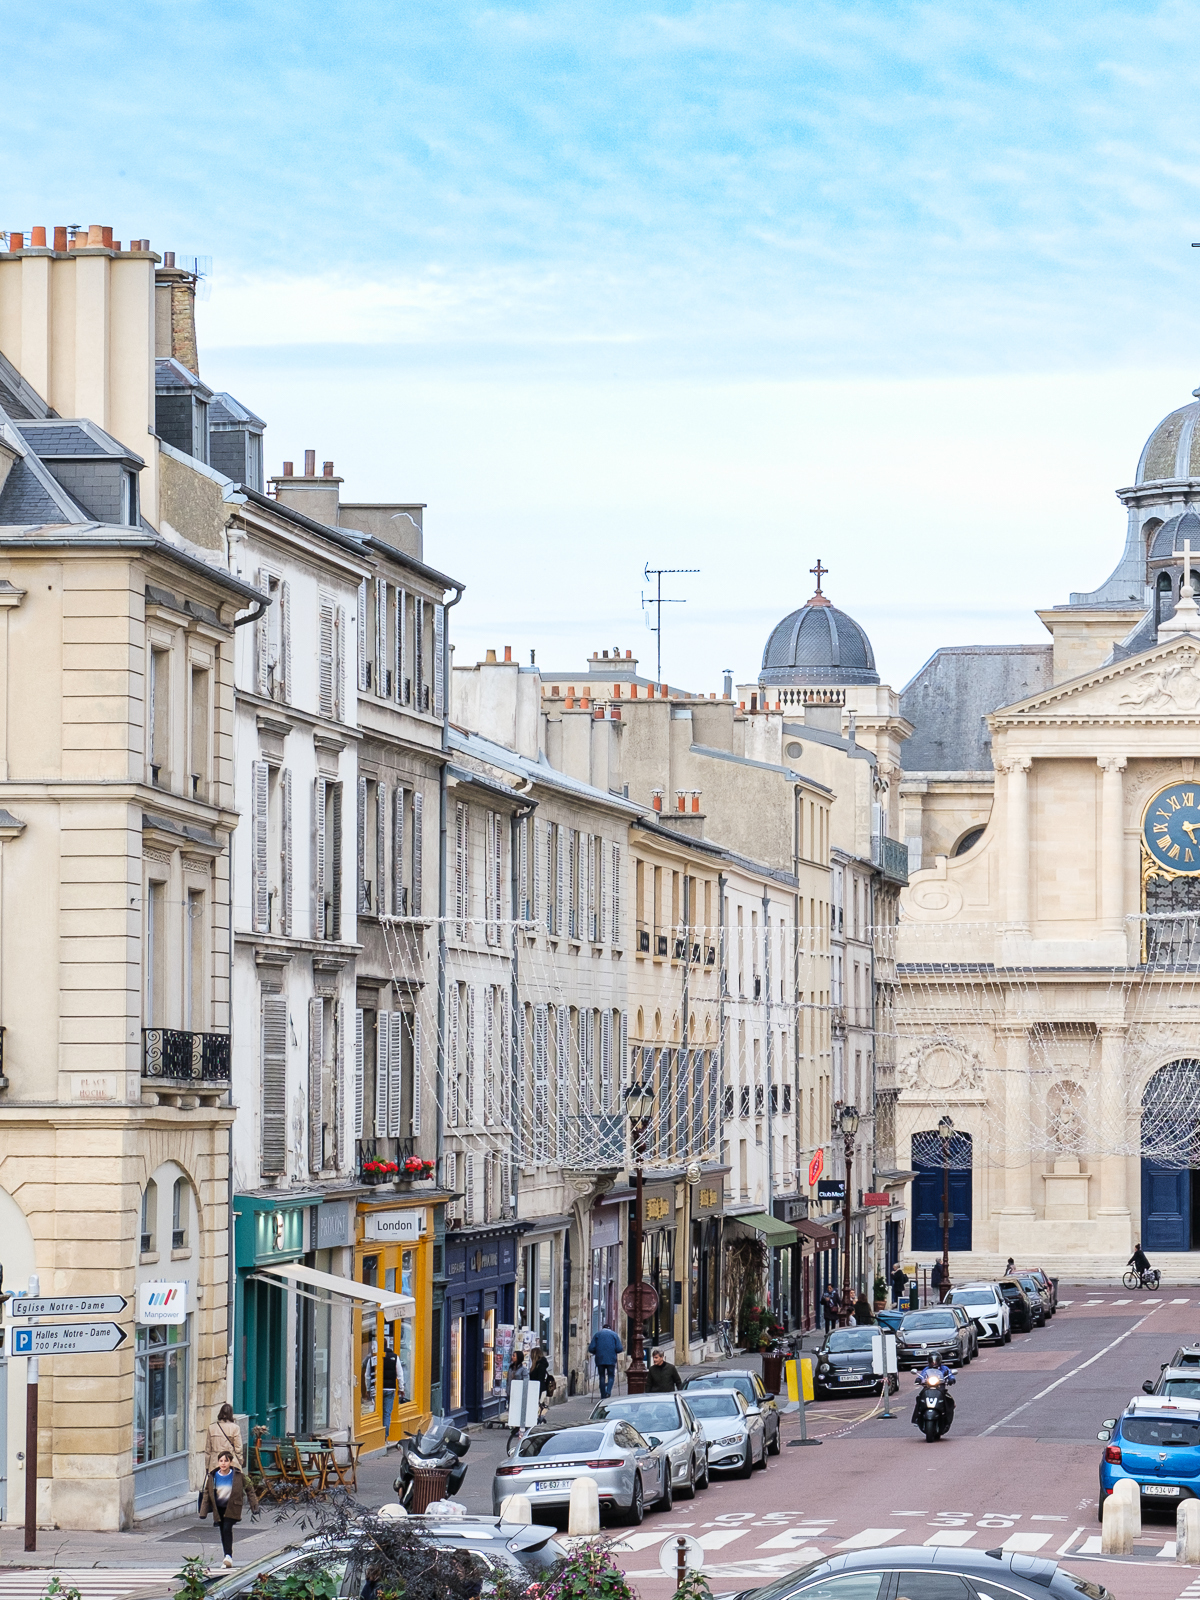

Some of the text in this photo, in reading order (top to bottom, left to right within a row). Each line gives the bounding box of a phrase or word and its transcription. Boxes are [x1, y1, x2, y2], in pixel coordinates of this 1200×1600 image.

[1182, 793, 1194, 806] XII
[320, 1214, 346, 1237] PROVOST
[377, 1220, 413, 1232] London
[17, 1301, 105, 1315] Eglise Notre-Dame
[144, 1311, 180, 1319] Manpower
[35, 1328, 111, 1340] Halles Notre-Dame
[35, 1341, 76, 1350] 700 Places
[889, 1510, 1069, 1522] ZONE
[926, 1517, 1015, 1528] 30
